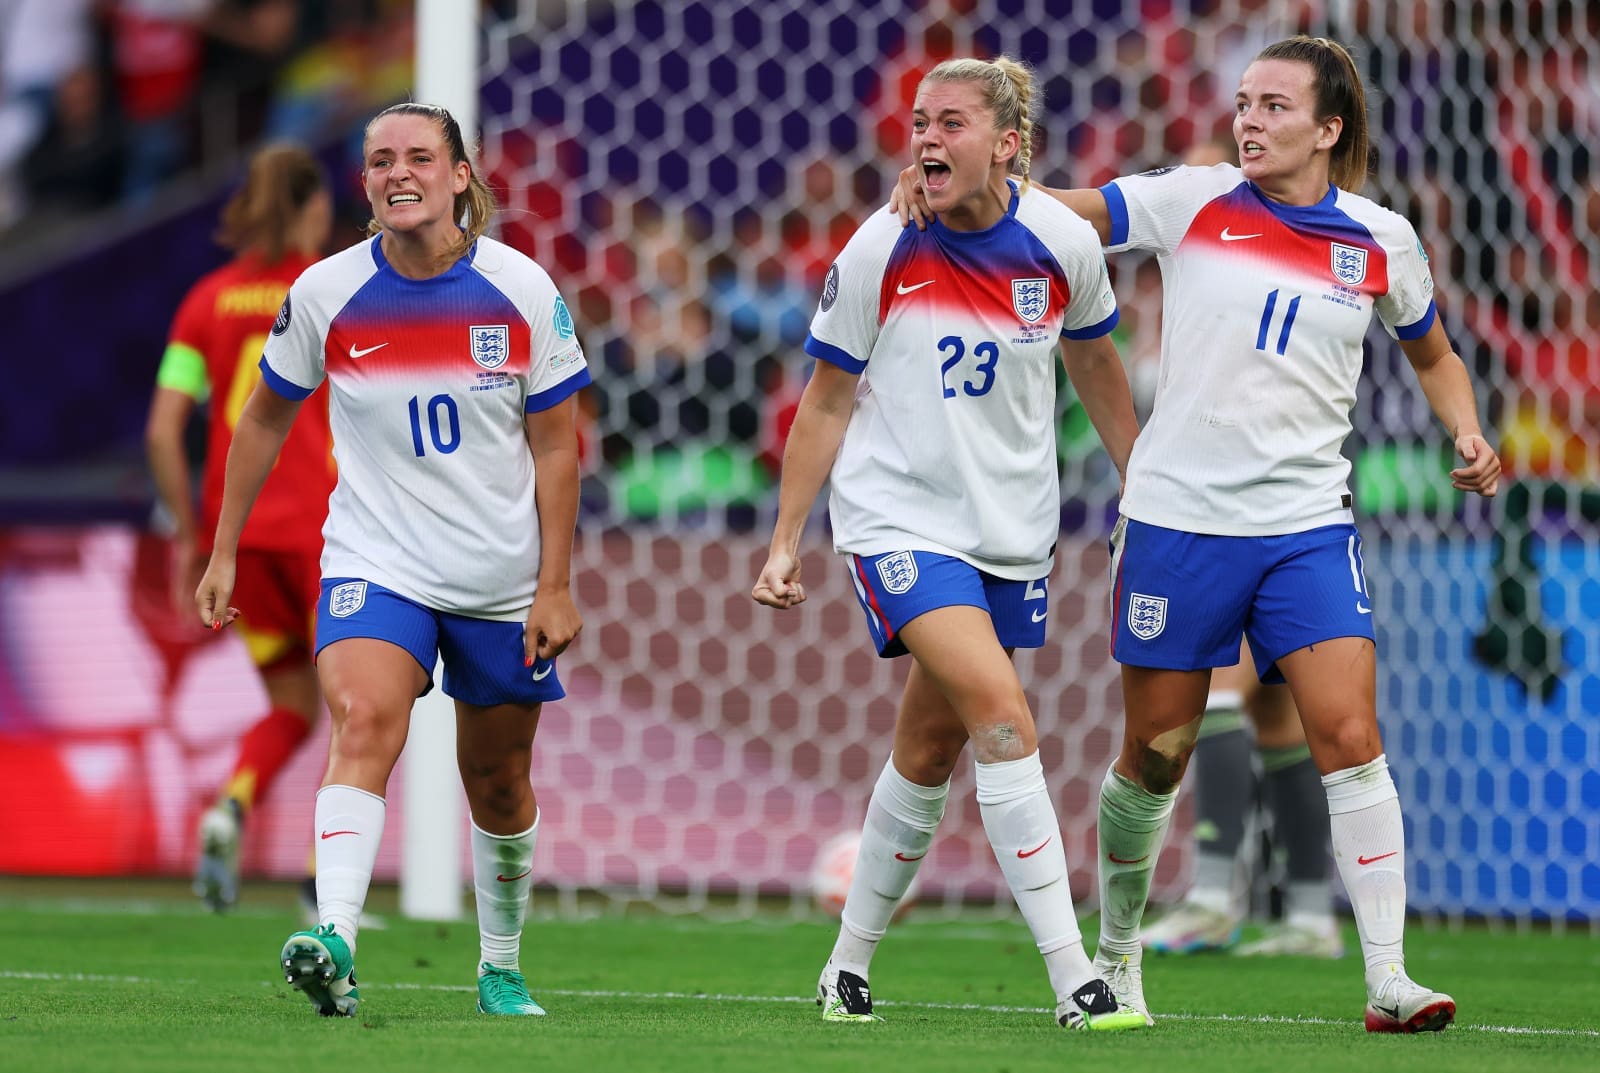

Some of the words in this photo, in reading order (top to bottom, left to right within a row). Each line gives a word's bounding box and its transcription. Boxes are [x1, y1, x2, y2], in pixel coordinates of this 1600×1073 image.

[1256, 288, 1302, 356] 11
[937, 335, 999, 399] 23
[408, 394, 461, 457] 10
